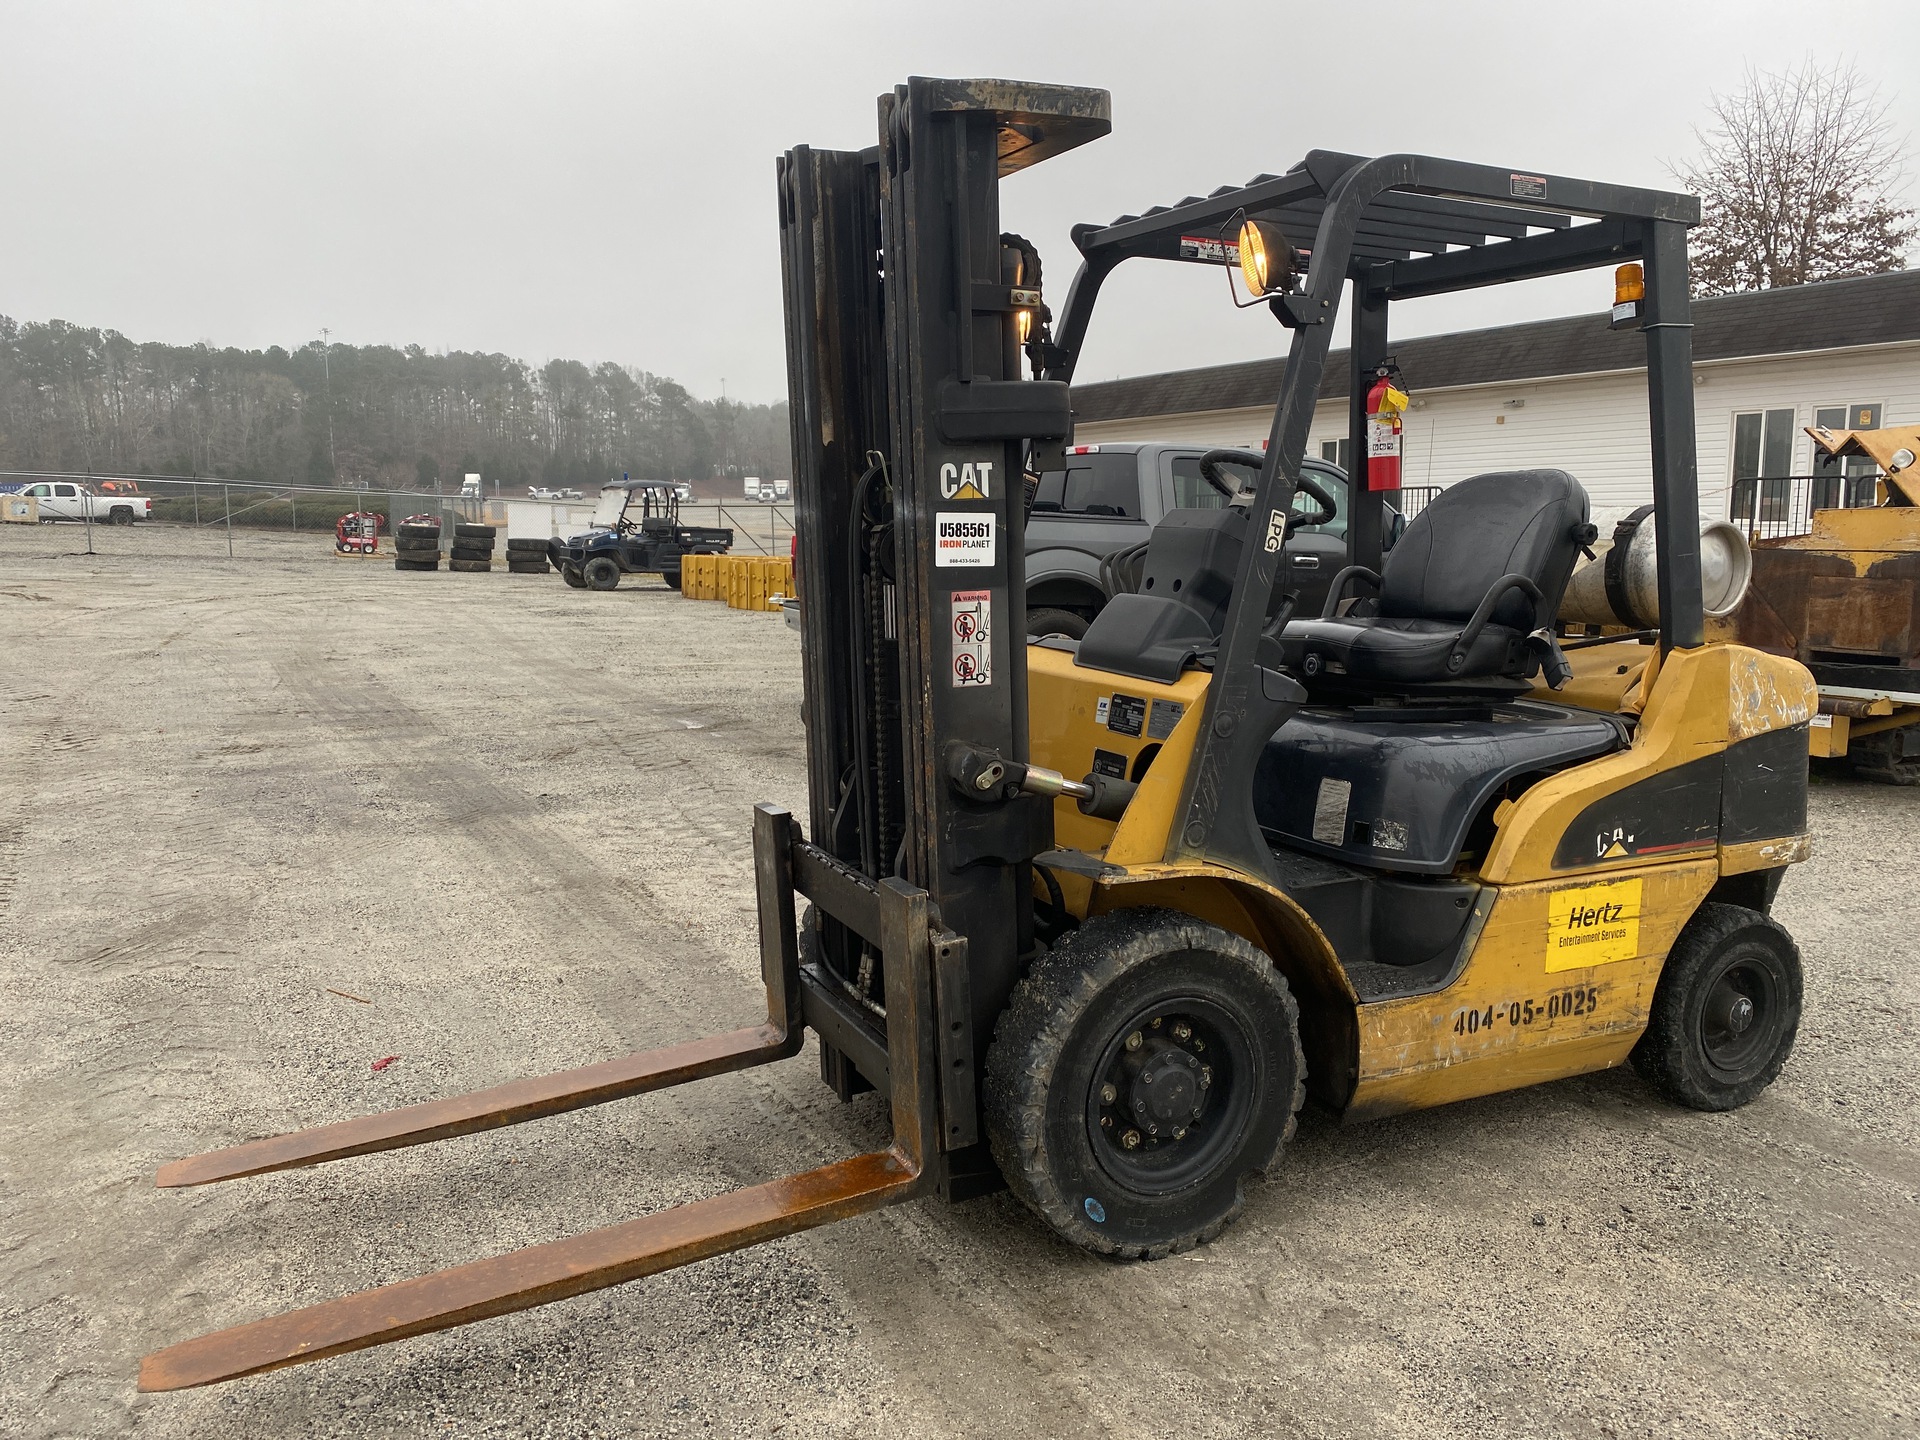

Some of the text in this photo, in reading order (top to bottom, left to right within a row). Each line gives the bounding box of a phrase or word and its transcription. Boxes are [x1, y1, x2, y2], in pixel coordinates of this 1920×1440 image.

[940, 462, 993, 499] CAT
[939, 522, 990, 539] U585561
[939, 539, 991, 549] IRON PLANET
[1267, 511, 1284, 551] LPG
[1567, 902, 1624, 930] Hertz
[1559, 928, 1626, 947] Entertainment Services
[1453, 987, 1598, 1036] 404-05-0025
